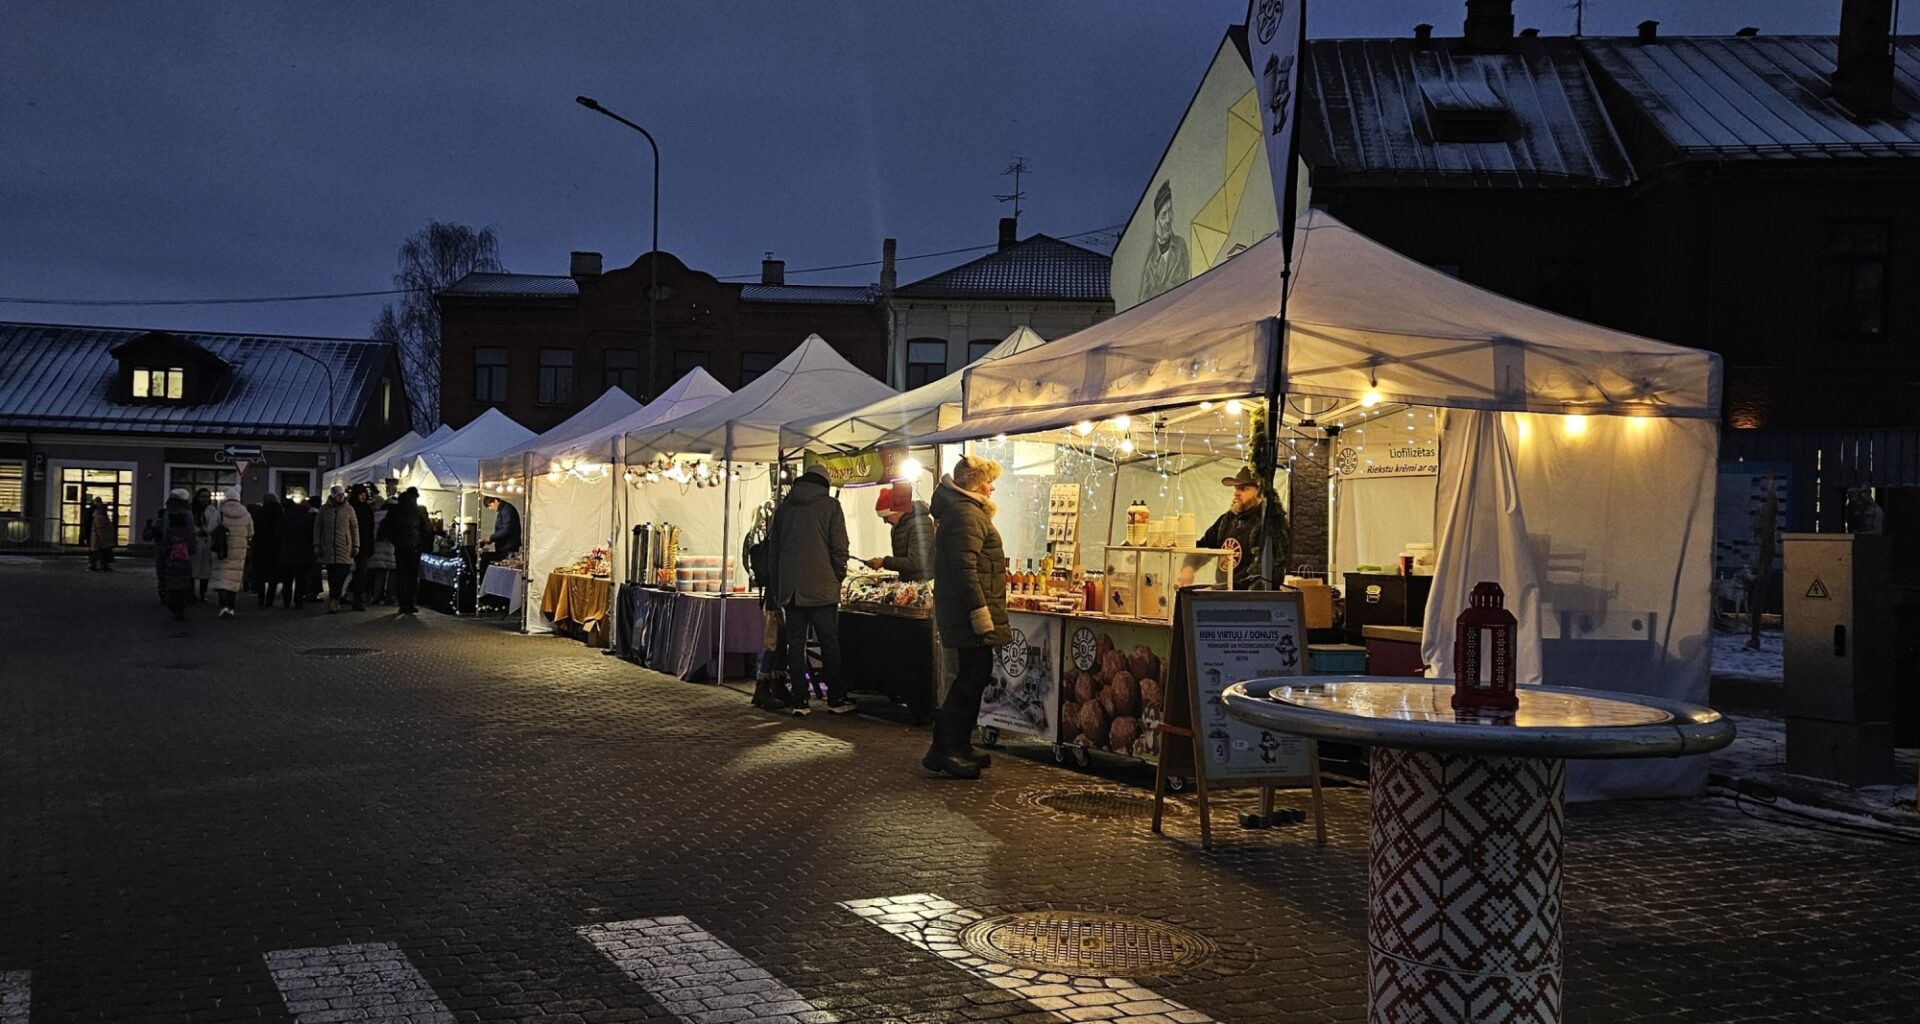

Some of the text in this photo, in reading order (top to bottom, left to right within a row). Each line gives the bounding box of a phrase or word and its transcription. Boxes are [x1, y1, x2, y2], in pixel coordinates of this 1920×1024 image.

[1390, 447, 1436, 458] Liofilizētas
[1367, 464, 1394, 474] Riekstu
[1394, 463, 1417, 472] krēmi
[1250, 630, 1279, 639] DONUTS
